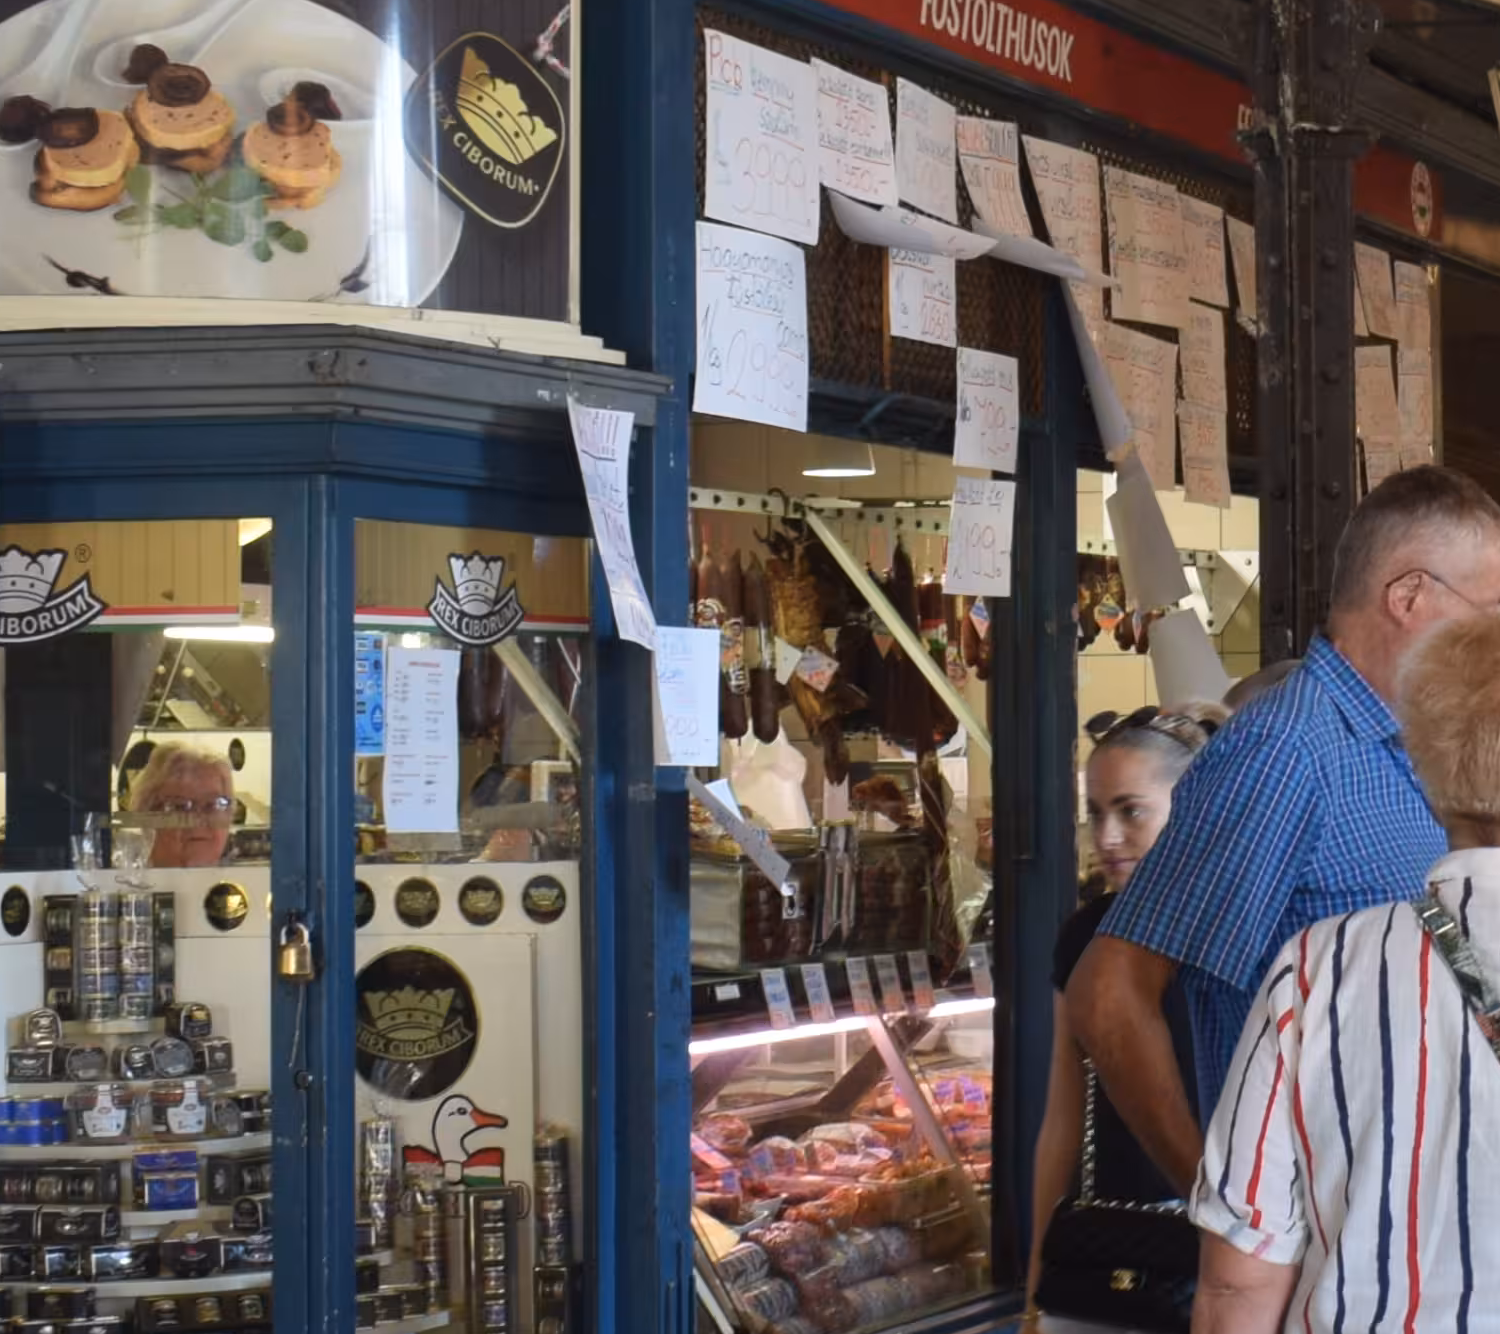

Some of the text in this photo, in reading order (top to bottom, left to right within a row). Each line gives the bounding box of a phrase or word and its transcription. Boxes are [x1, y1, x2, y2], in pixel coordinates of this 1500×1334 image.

[453, 132, 534, 196] CIBORUM
[436, 597, 517, 637] REX CIBORUM
